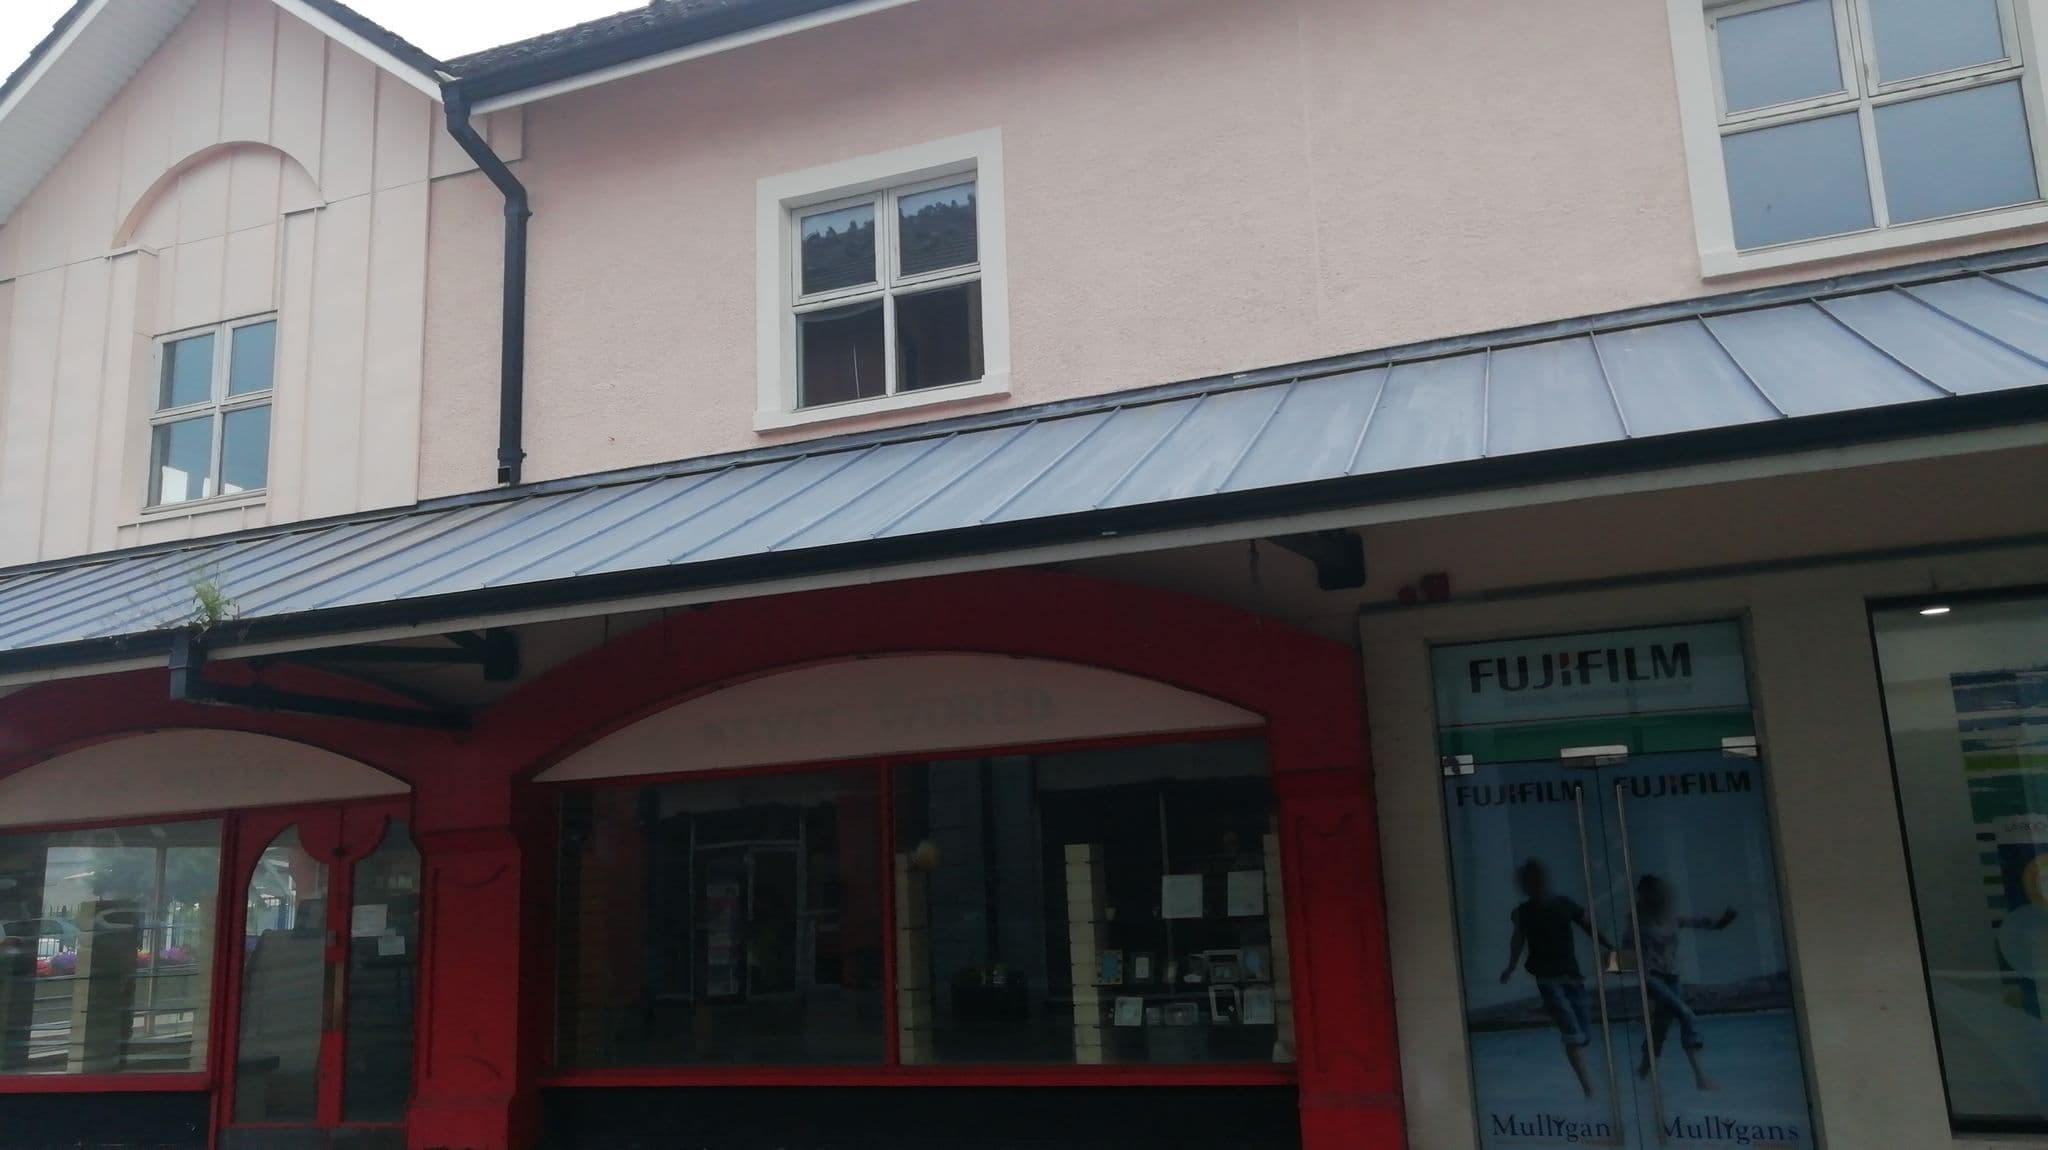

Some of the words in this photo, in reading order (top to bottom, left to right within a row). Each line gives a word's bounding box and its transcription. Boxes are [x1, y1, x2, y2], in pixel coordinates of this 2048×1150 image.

[1469, 641, 1692, 693] FUJIFILM
[1456, 779, 1586, 808] FUJIFILM
[1612, 769, 1752, 798] FUJIFILM
[1492, 1112, 1613, 1143] Mulligan
